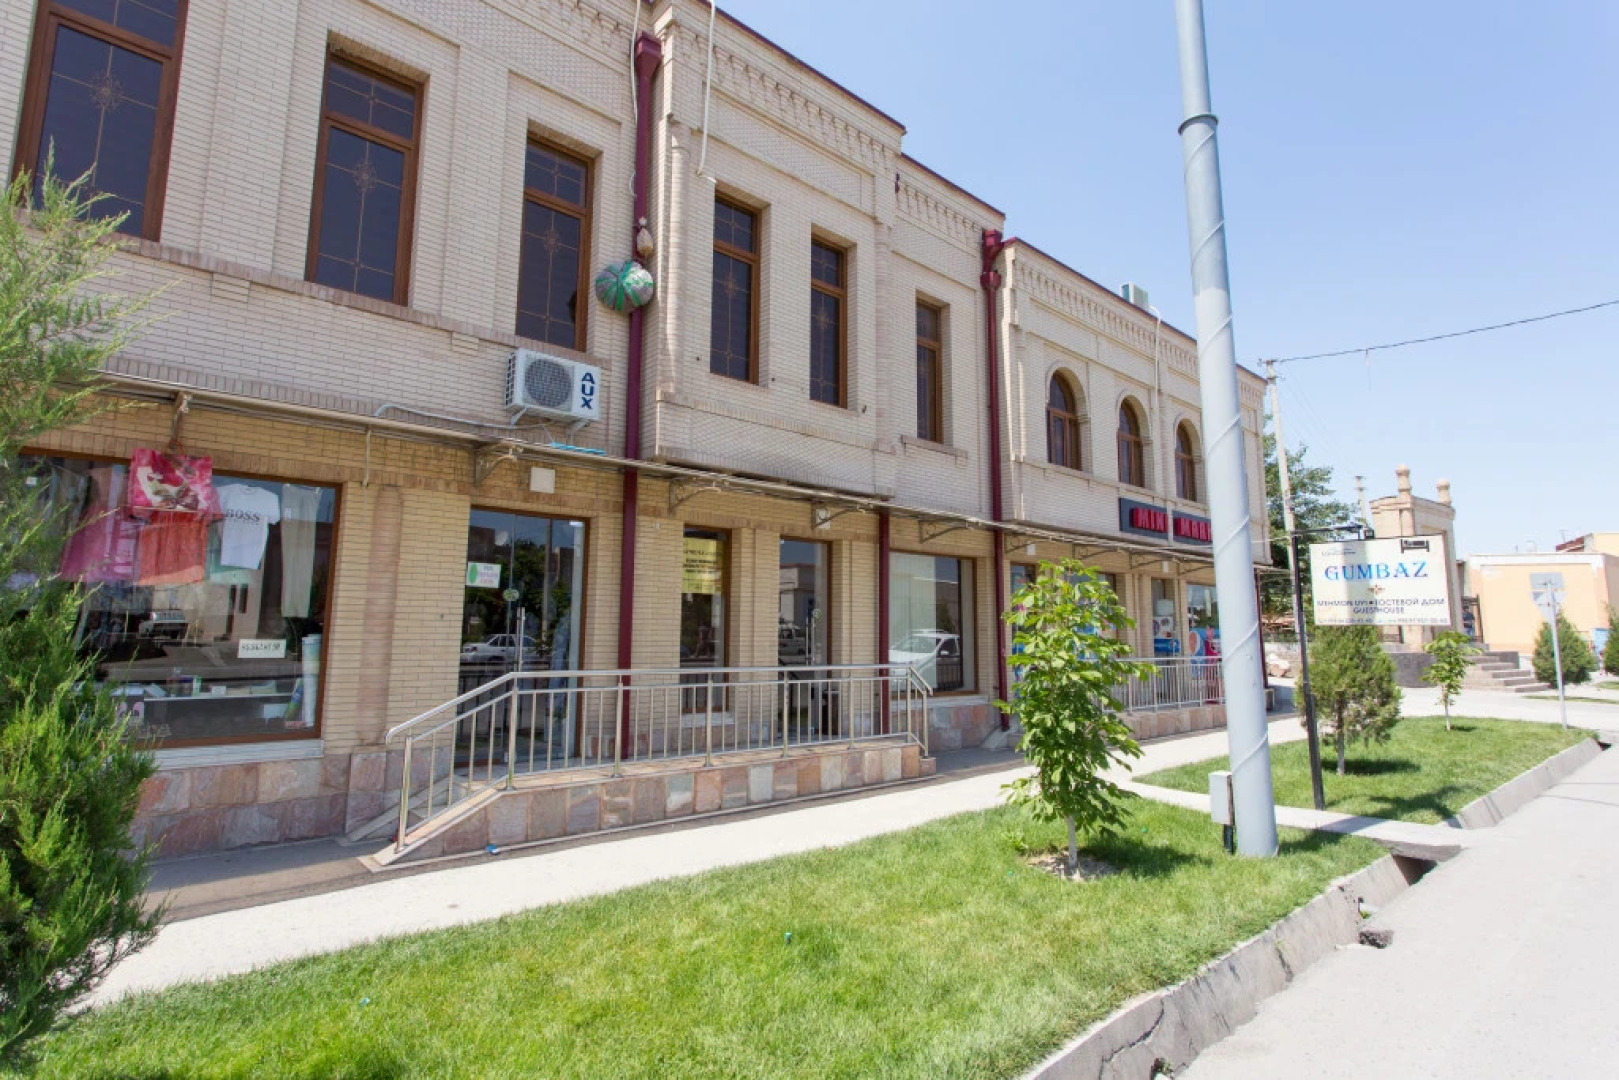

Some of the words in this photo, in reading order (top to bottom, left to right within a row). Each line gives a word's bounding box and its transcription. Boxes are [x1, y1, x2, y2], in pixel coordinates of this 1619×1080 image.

[581, 372, 595, 410] AUX
[226, 509, 260, 521] BOSS
[1325, 561, 1428, 581] GUMBAZ
[1374, 597, 1418, 606] ГОСТЕВОЙ
[1421, 598, 1444, 606] ДОМ
